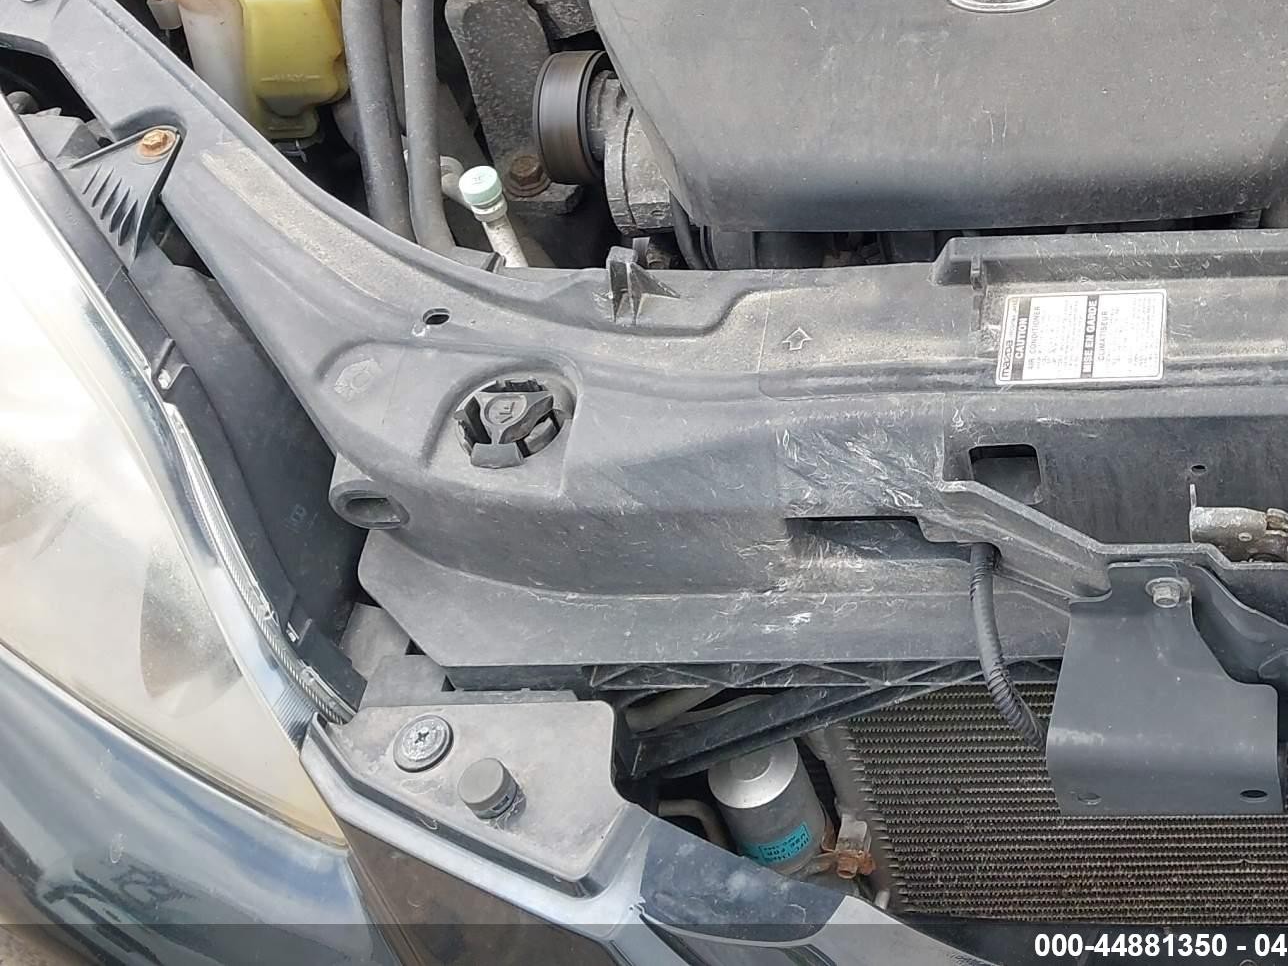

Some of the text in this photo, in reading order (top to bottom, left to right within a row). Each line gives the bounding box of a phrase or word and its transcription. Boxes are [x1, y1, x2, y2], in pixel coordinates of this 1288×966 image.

[1015, 317, 1028, 359] CAUTION
[1029, 306, 1041, 354] CONDITIONER
[1082, 299, 1098, 373] MISE EN GARDE
[1098, 310, 1109, 361] CLIMATISEUR
[1002, 339, 1014, 378] mazda
